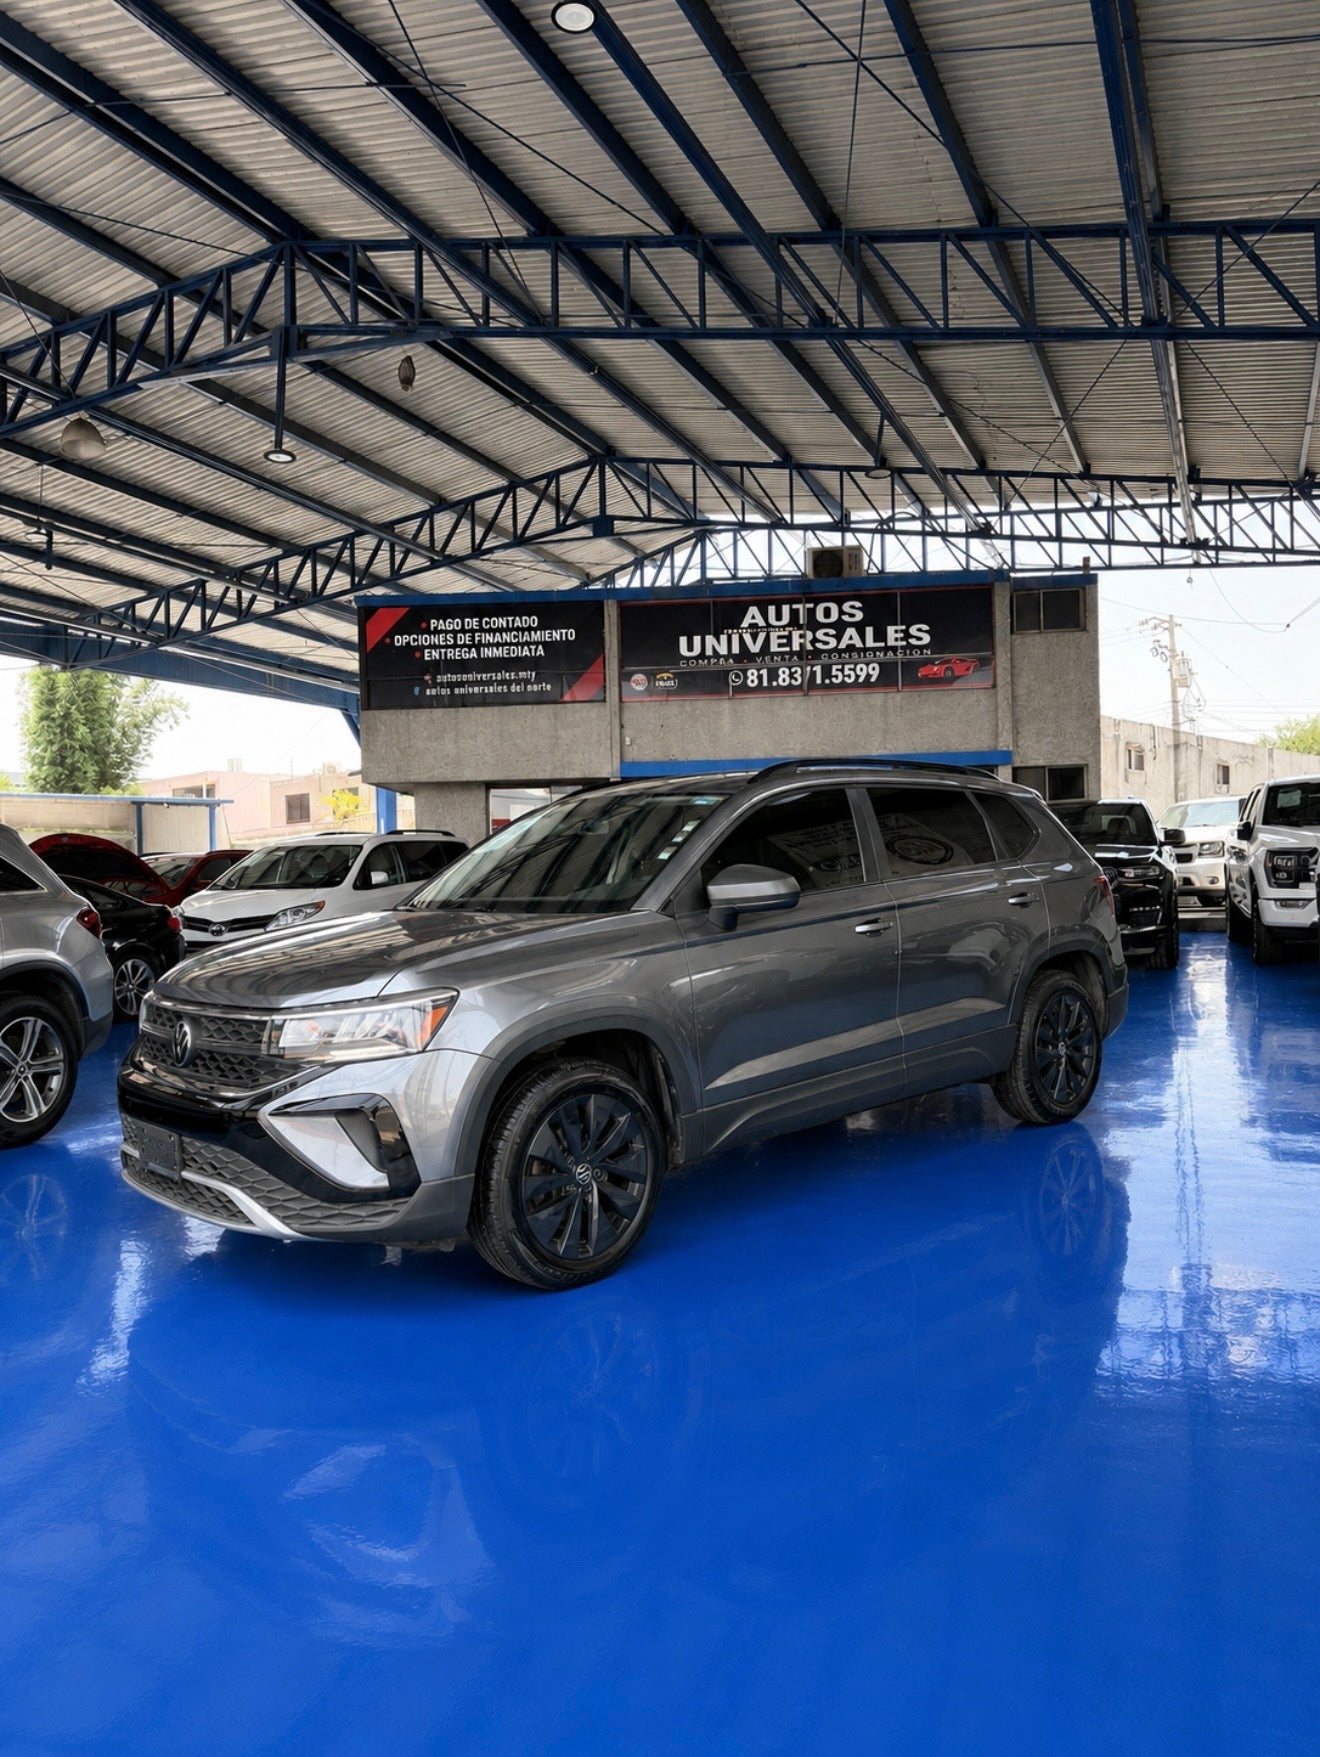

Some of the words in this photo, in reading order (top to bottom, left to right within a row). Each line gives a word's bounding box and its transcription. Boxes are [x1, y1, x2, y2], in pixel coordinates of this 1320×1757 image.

[740, 601, 864, 628] AUTOS
[430, 618, 462, 631] PAGO
[464, 617, 480, 630] DE
[482, 616, 538, 629] CONTADO
[394, 633, 454, 646] OPCIONES
[457, 633, 473, 644] DE
[474, 629, 576, 644] FINANCIAMIENTO
[679, 623, 932, 657] UNIVERSALES
[424, 647, 478, 660] ENTREGA
[480, 645, 545, 659] INMEDIATA
[756, 655, 799, 664] VENTA
